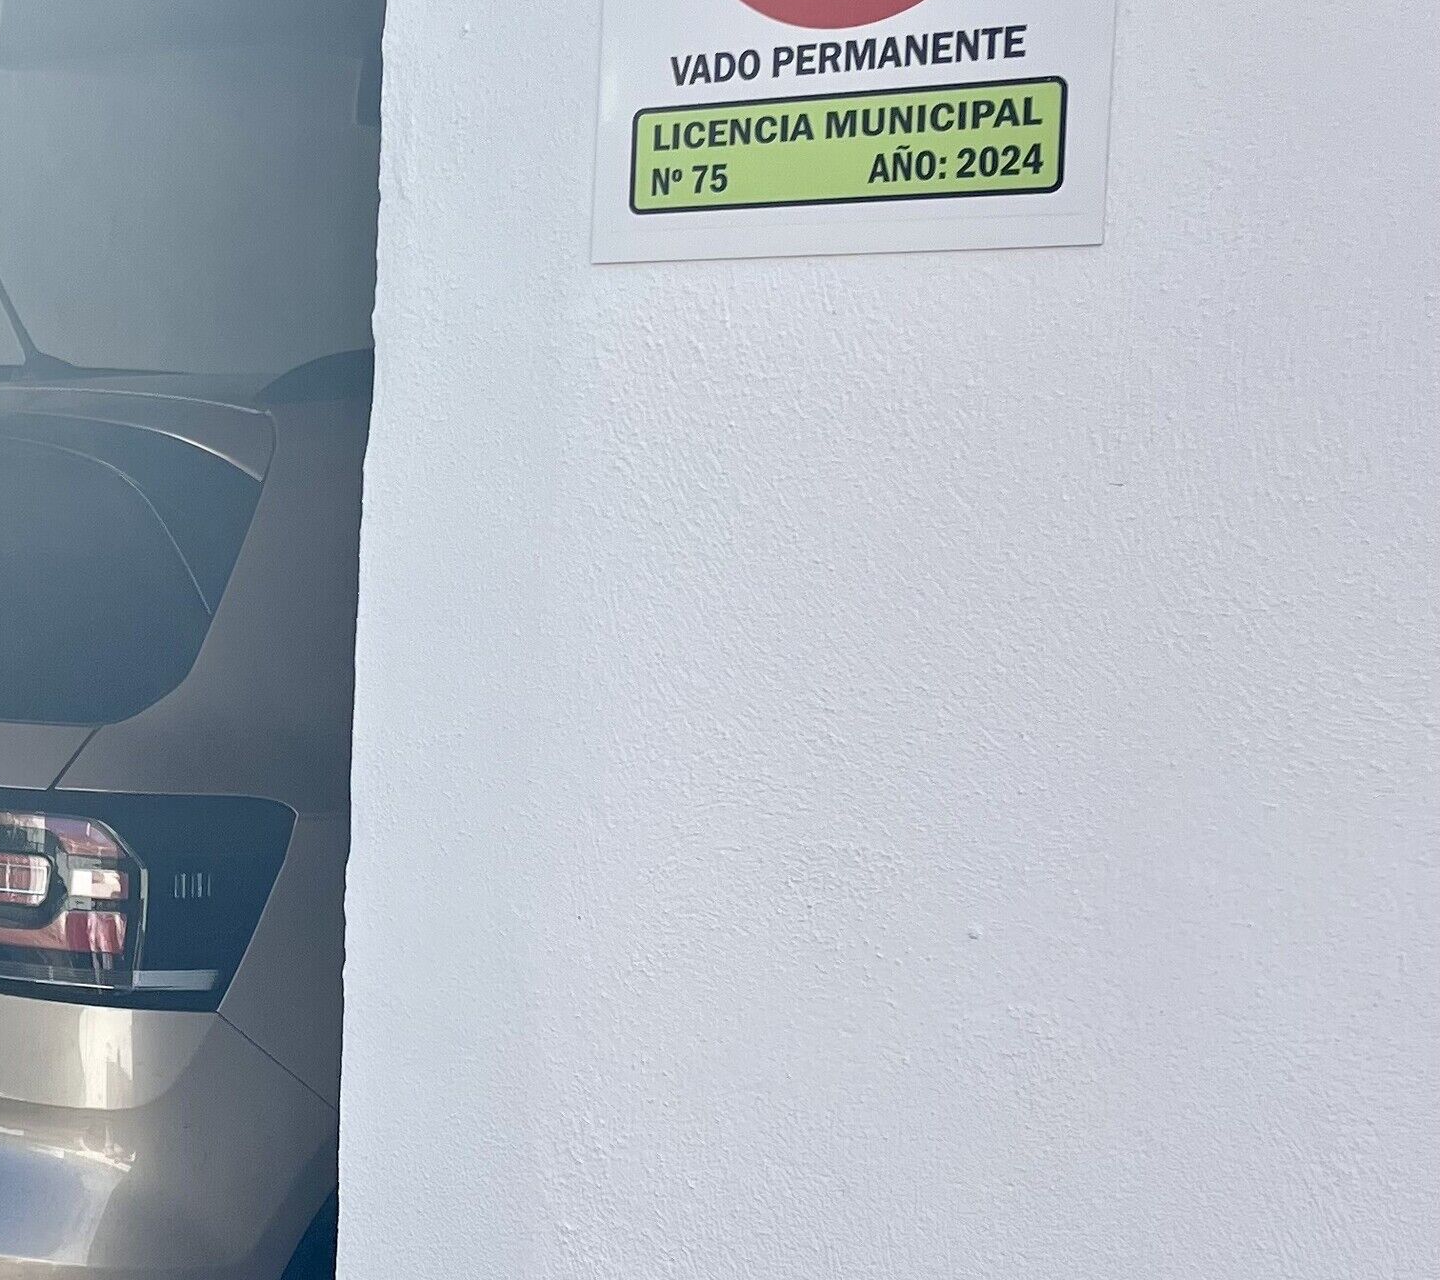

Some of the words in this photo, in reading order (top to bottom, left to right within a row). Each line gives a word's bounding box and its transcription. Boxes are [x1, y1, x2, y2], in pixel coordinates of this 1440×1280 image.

[671, 49, 760, 86] VADO
[772, 25, 1028, 78] PERMANENTE
[653, 114, 814, 151] LICENCIA
[825, 96, 1043, 139] MUNICIPAL
[651, 167, 682, 196] Nº
[692, 163, 728, 193] 75
[868, 145, 947, 183] AÑO:
[956, 143, 1043, 178] 2024
